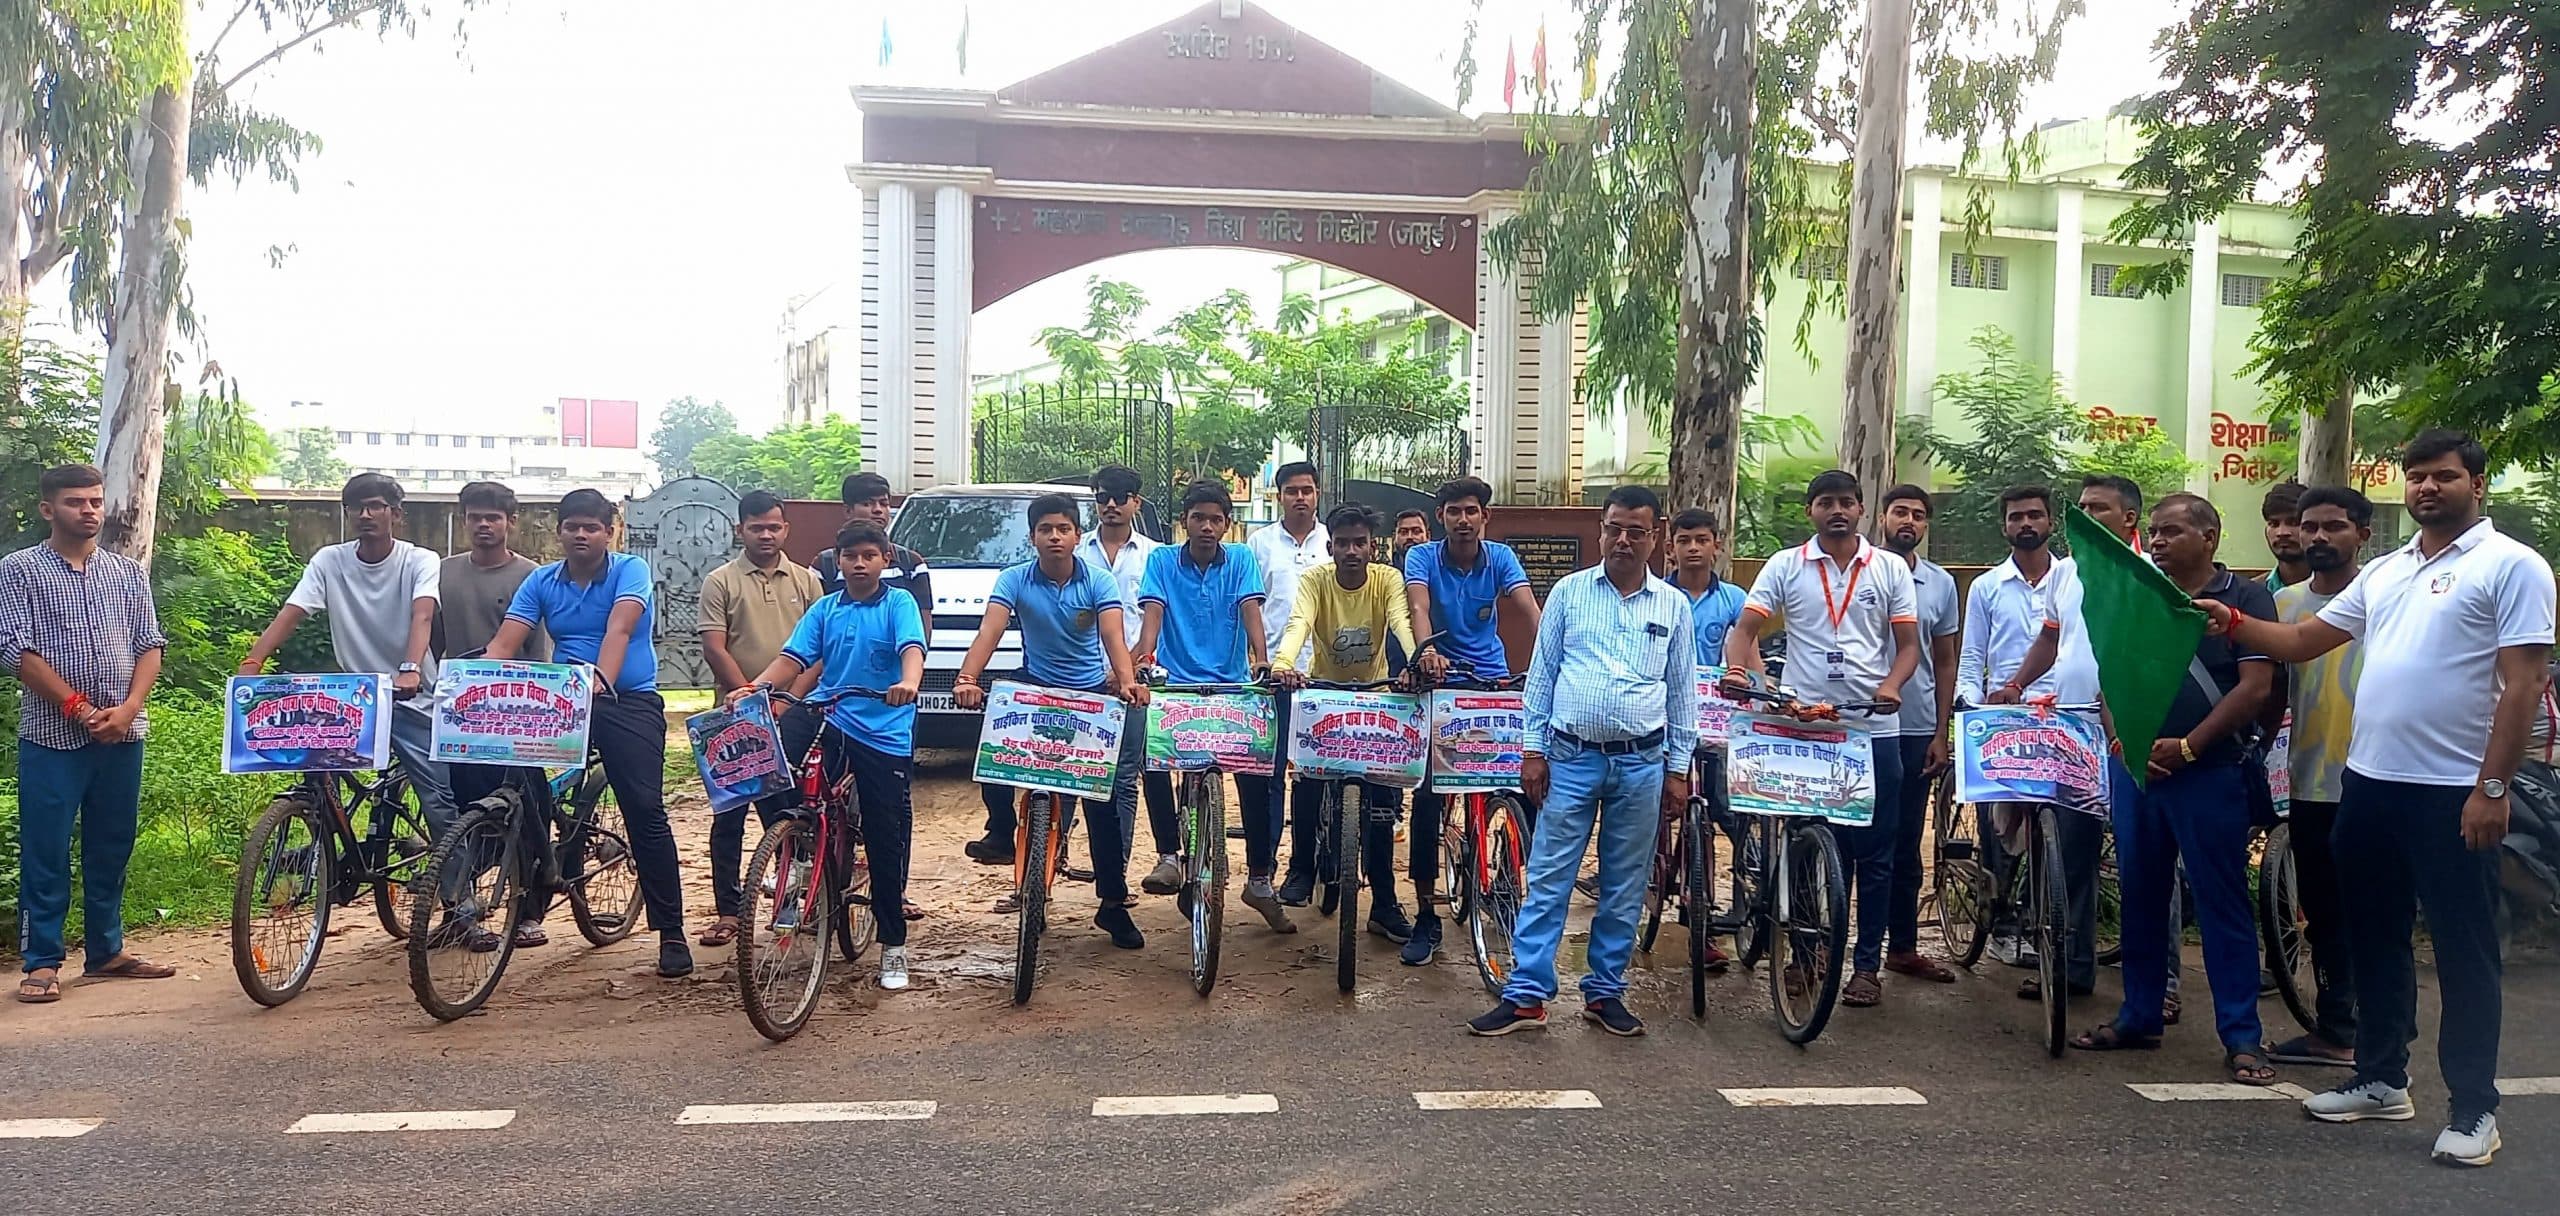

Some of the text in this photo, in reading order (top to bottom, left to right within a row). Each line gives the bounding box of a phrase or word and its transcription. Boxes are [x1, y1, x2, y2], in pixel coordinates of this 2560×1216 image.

[1031, 712, 1049, 725] यात्रा
[1052, 714, 1067, 726] एक
[1493, 716, 1506, 727] एक
[1075, 747, 1105, 760] हमारे
[1795, 745, 1810, 757] एक
